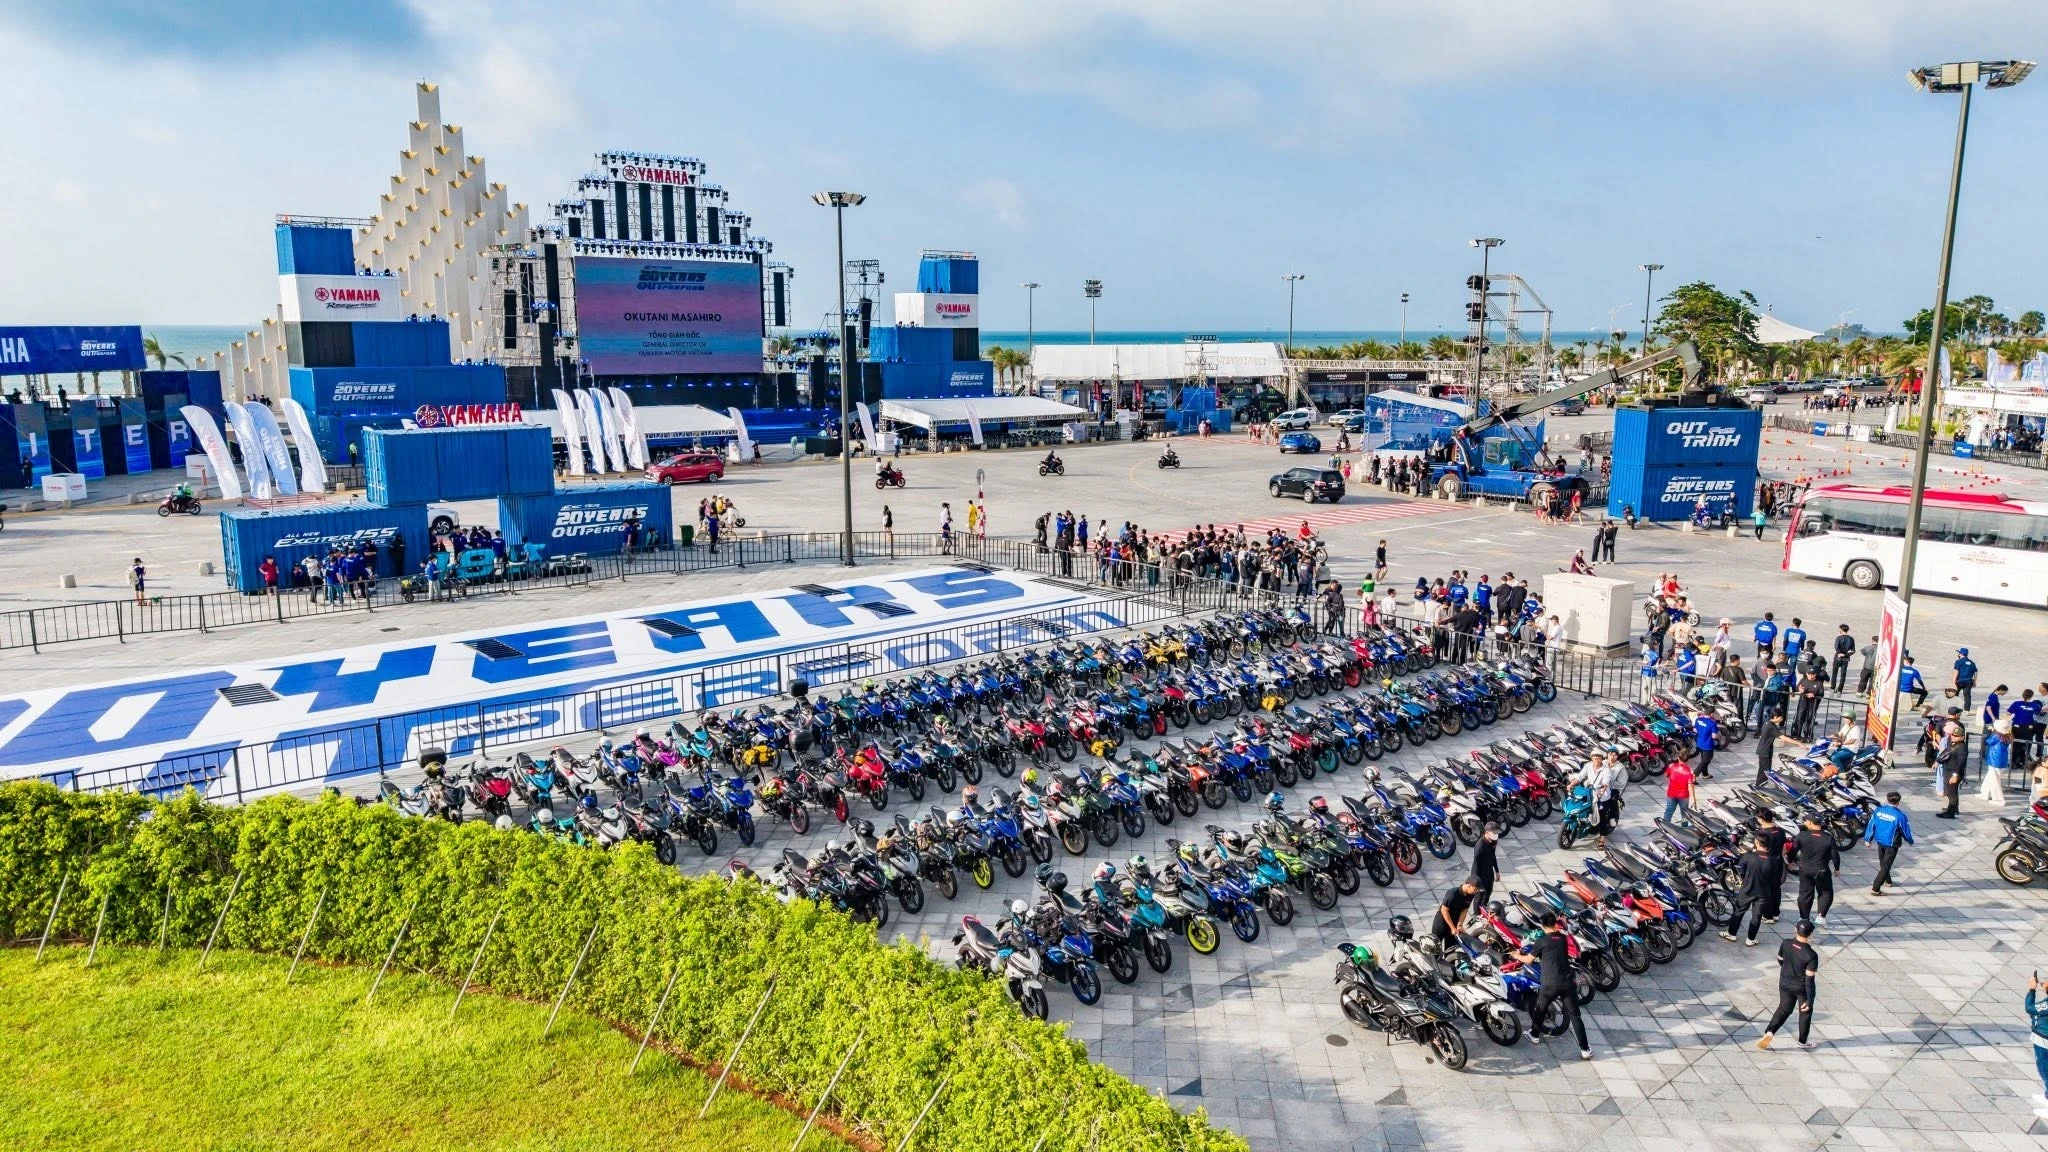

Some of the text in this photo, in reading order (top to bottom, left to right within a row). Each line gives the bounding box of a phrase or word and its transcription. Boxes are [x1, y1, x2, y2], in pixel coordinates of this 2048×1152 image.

[637, 167, 689, 185] YAMAHA
[330, 288, 381, 301] YAMAHA
[943, 303, 971, 313] YAMAHA
[624, 312, 722, 322] OKUTANI MASAHIRO
[0, 337, 31, 364] HA
[440, 402, 523, 427] YAMAHA
[1666, 421, 1709, 435] OUT
[273, 526, 400, 548] EXCITER 155
